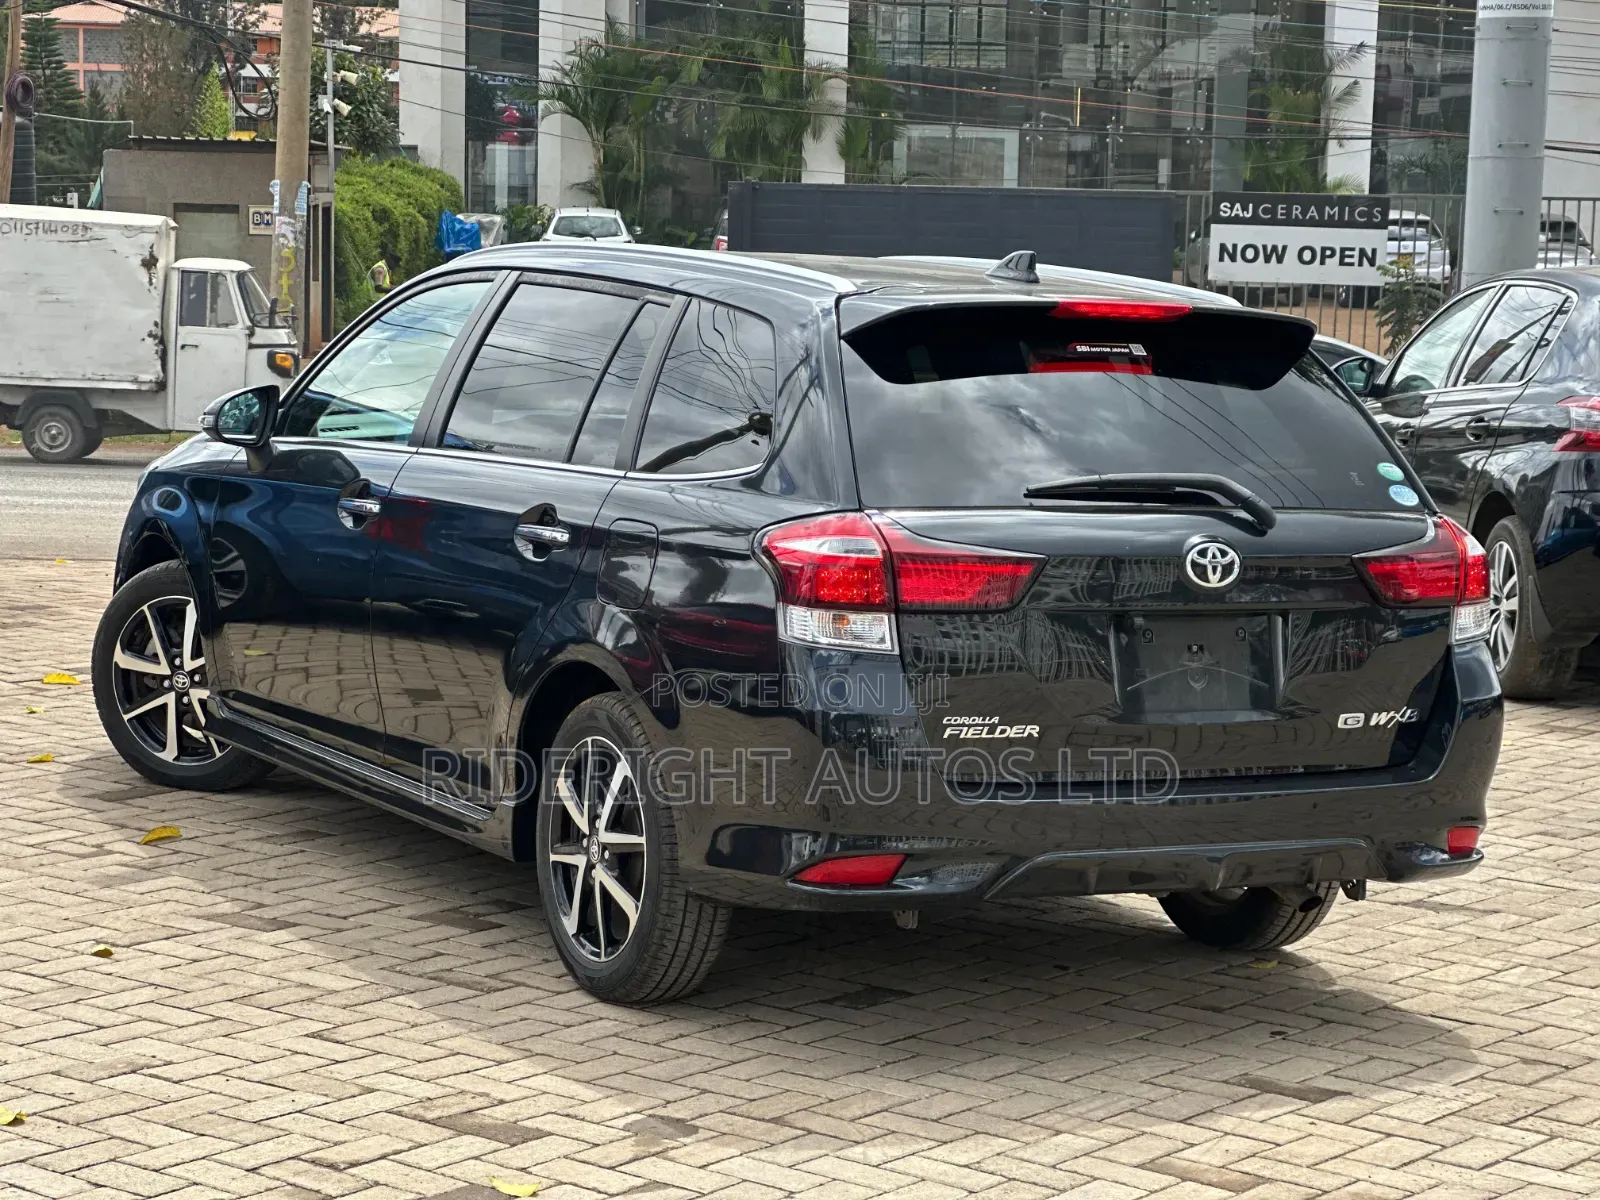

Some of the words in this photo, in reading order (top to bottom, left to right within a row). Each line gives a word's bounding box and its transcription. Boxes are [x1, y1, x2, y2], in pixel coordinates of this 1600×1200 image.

[1219, 202, 1253, 218] SAJ
[1258, 203, 1382, 222] CERAMICS
[1218, 242, 1289, 264] NOW
[1297, 245, 1378, 268] OPEN
[942, 716, 1000, 725] COROLLA
[1338, 713, 1365, 728] G
[942, 725, 1040, 739] FIELDER
